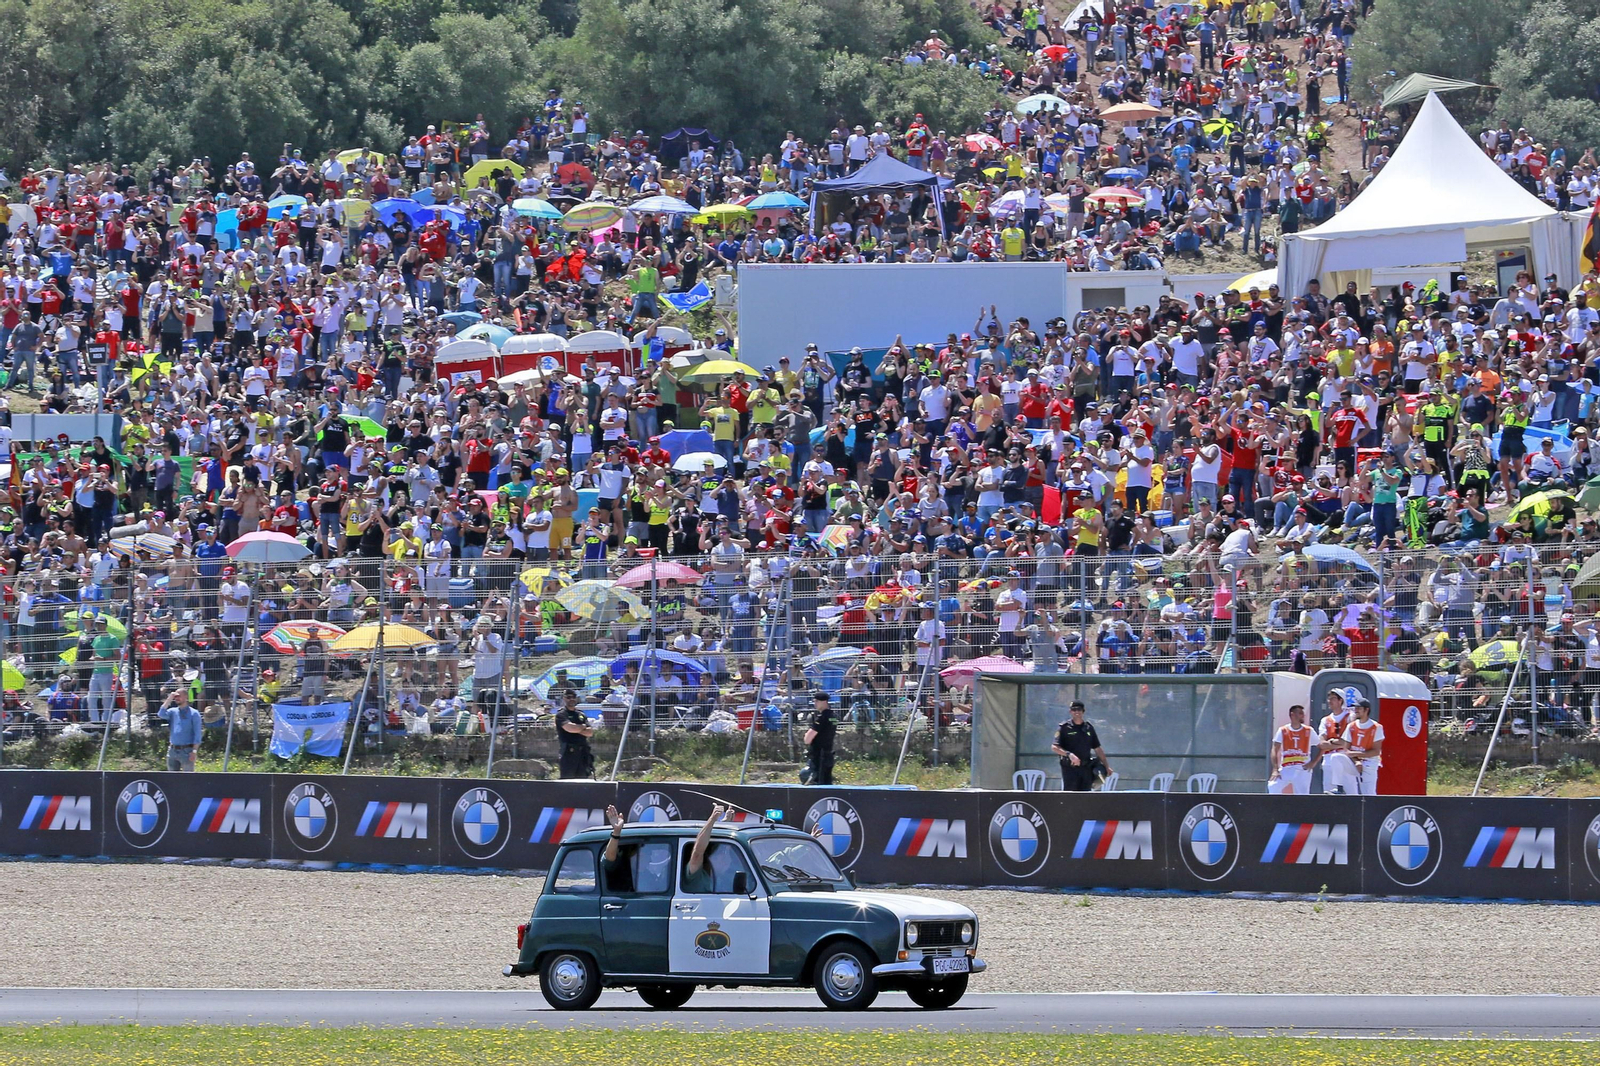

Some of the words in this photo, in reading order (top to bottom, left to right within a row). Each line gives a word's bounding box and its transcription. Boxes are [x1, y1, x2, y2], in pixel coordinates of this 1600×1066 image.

[389, 465, 407, 474] 46
[701, 481, 718, 490] 46
[121, 782, 164, 804] BMW
[288, 785, 332, 807] BMW
[458, 790, 505, 814] BMW
[633, 794, 678, 816] BMW
[808, 800, 858, 824] BMW
[994, 804, 1043, 828] BMW
[1185, 806, 1234, 831] BMW
[1384, 809, 1436, 834] BMW
[694, 946, 716, 959] GUARDIA
[716, 947, 731, 959] CIVIL
